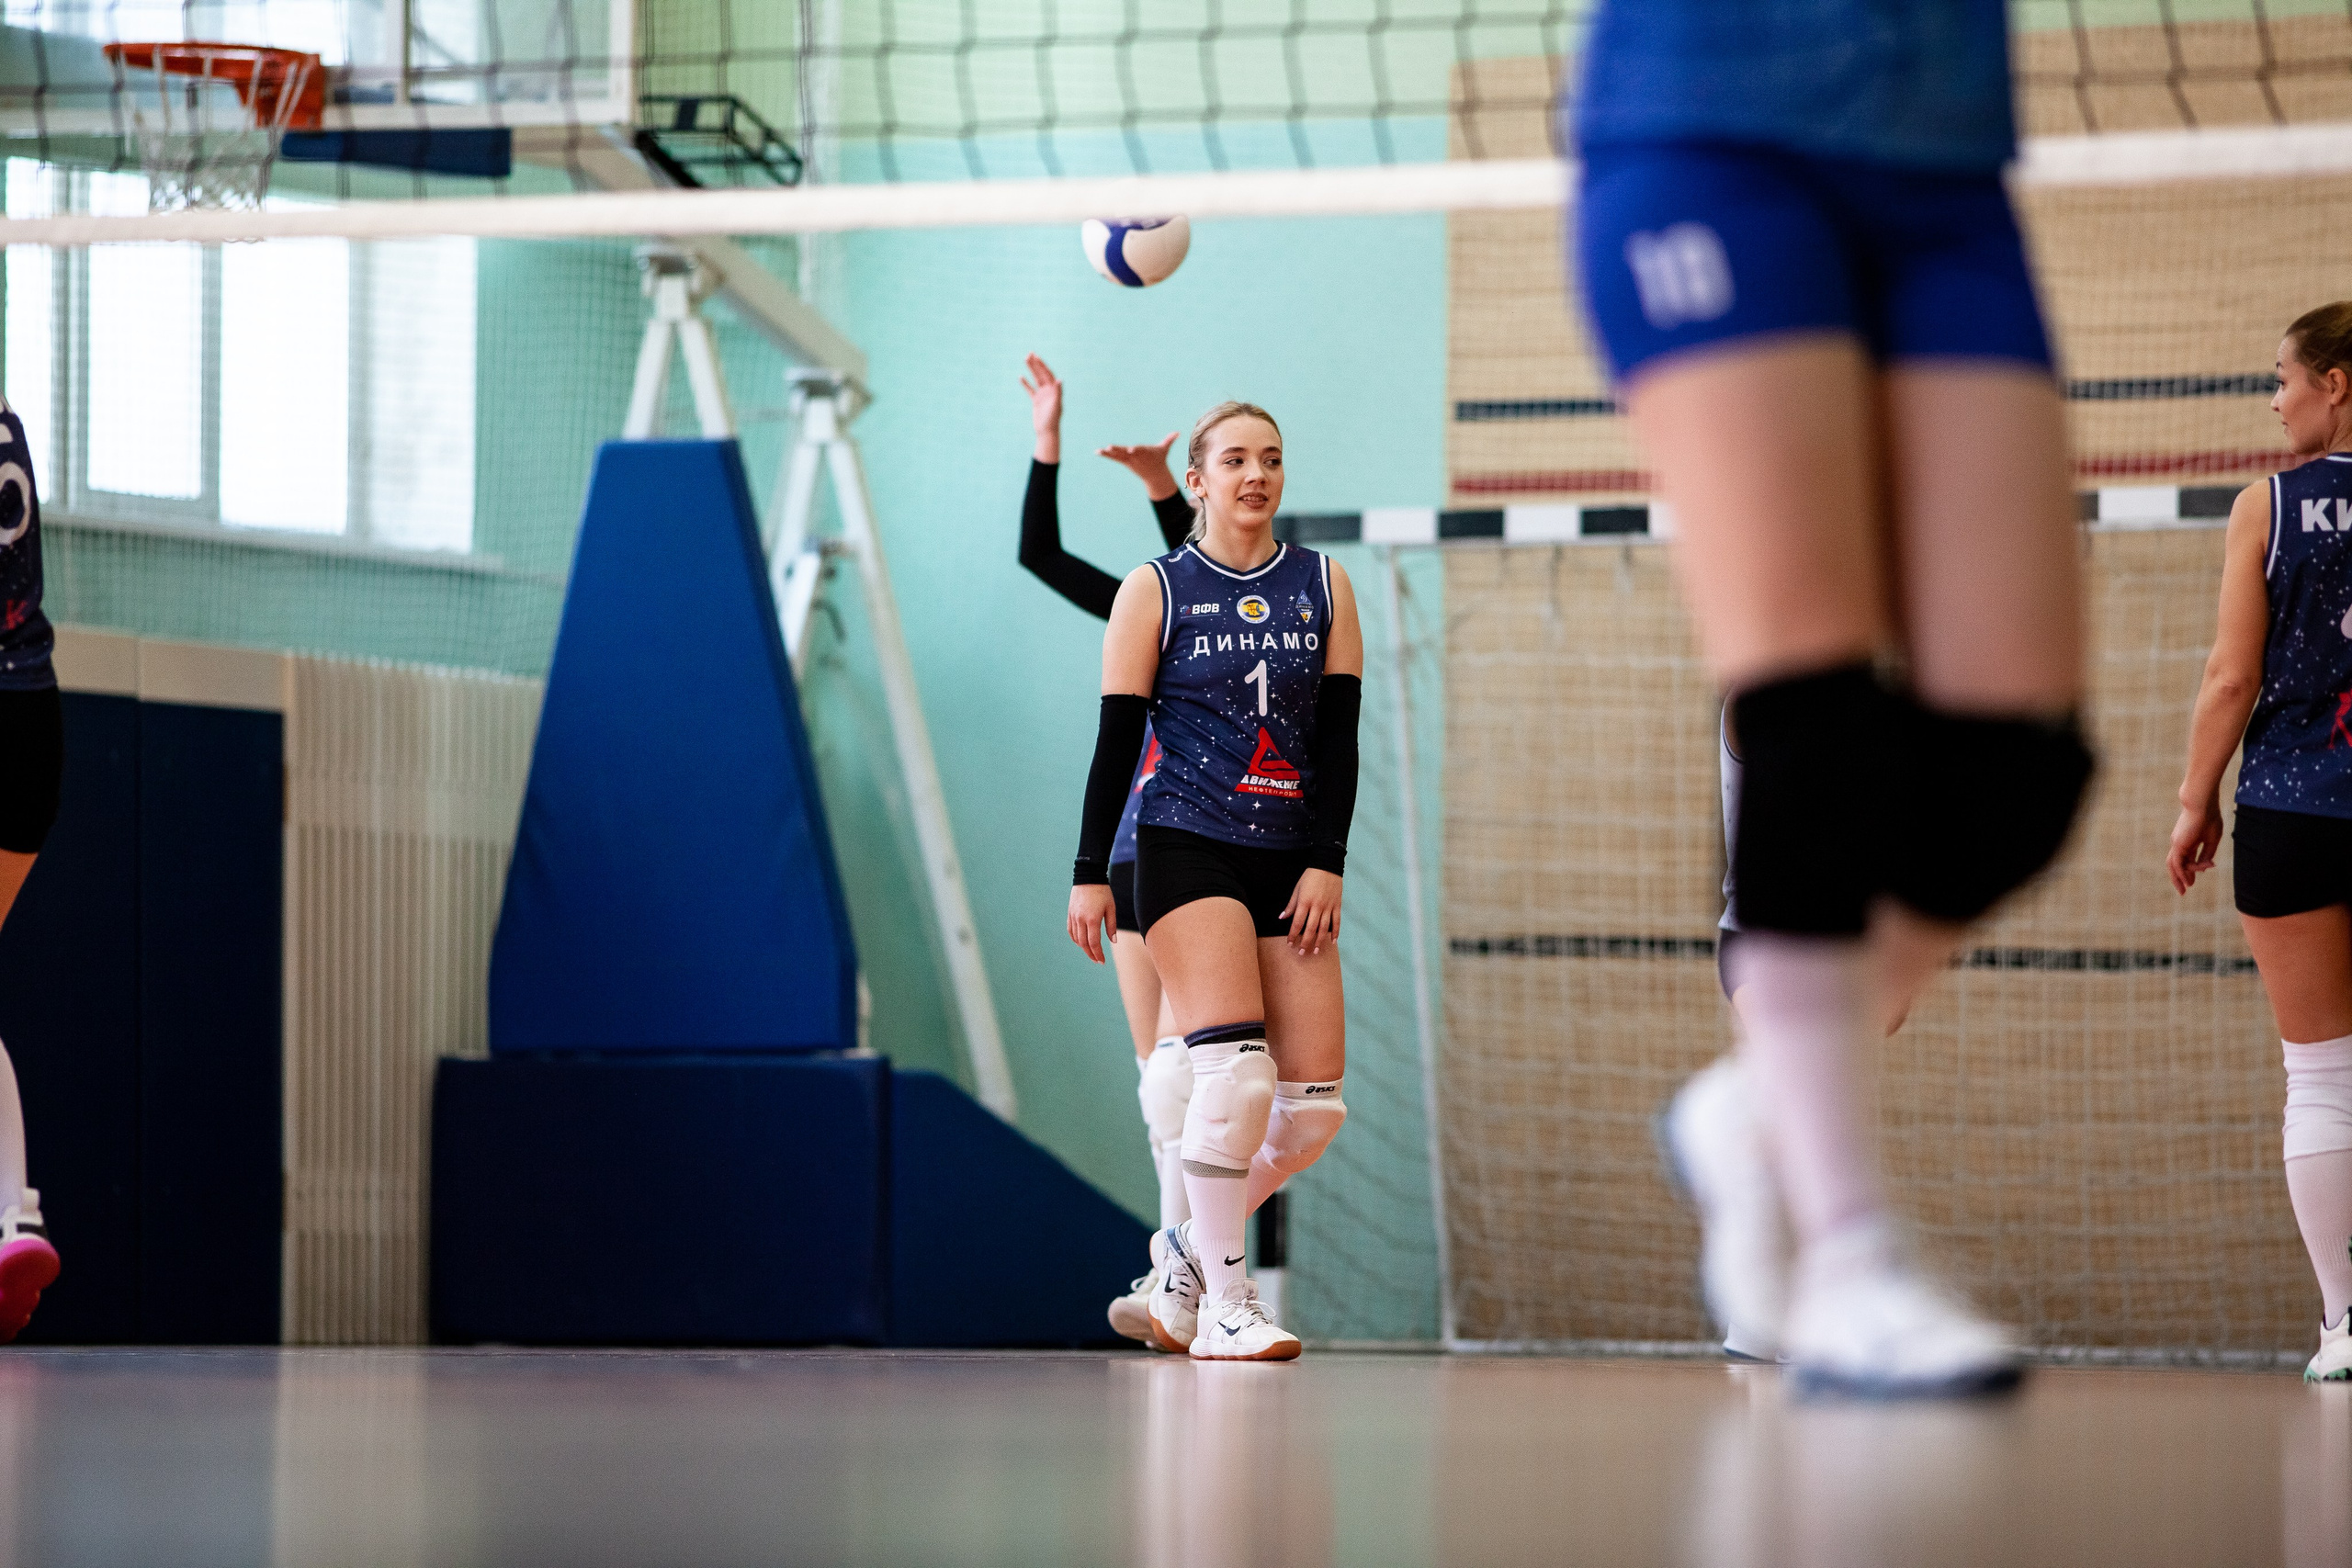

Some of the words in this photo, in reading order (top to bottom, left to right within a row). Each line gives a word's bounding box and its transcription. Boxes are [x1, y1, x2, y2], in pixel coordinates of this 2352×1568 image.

[1192, 604, 1220, 615] ВФВ
[1193, 632, 1319, 658] ДИНАМО
[1244, 659, 1268, 716] 1
